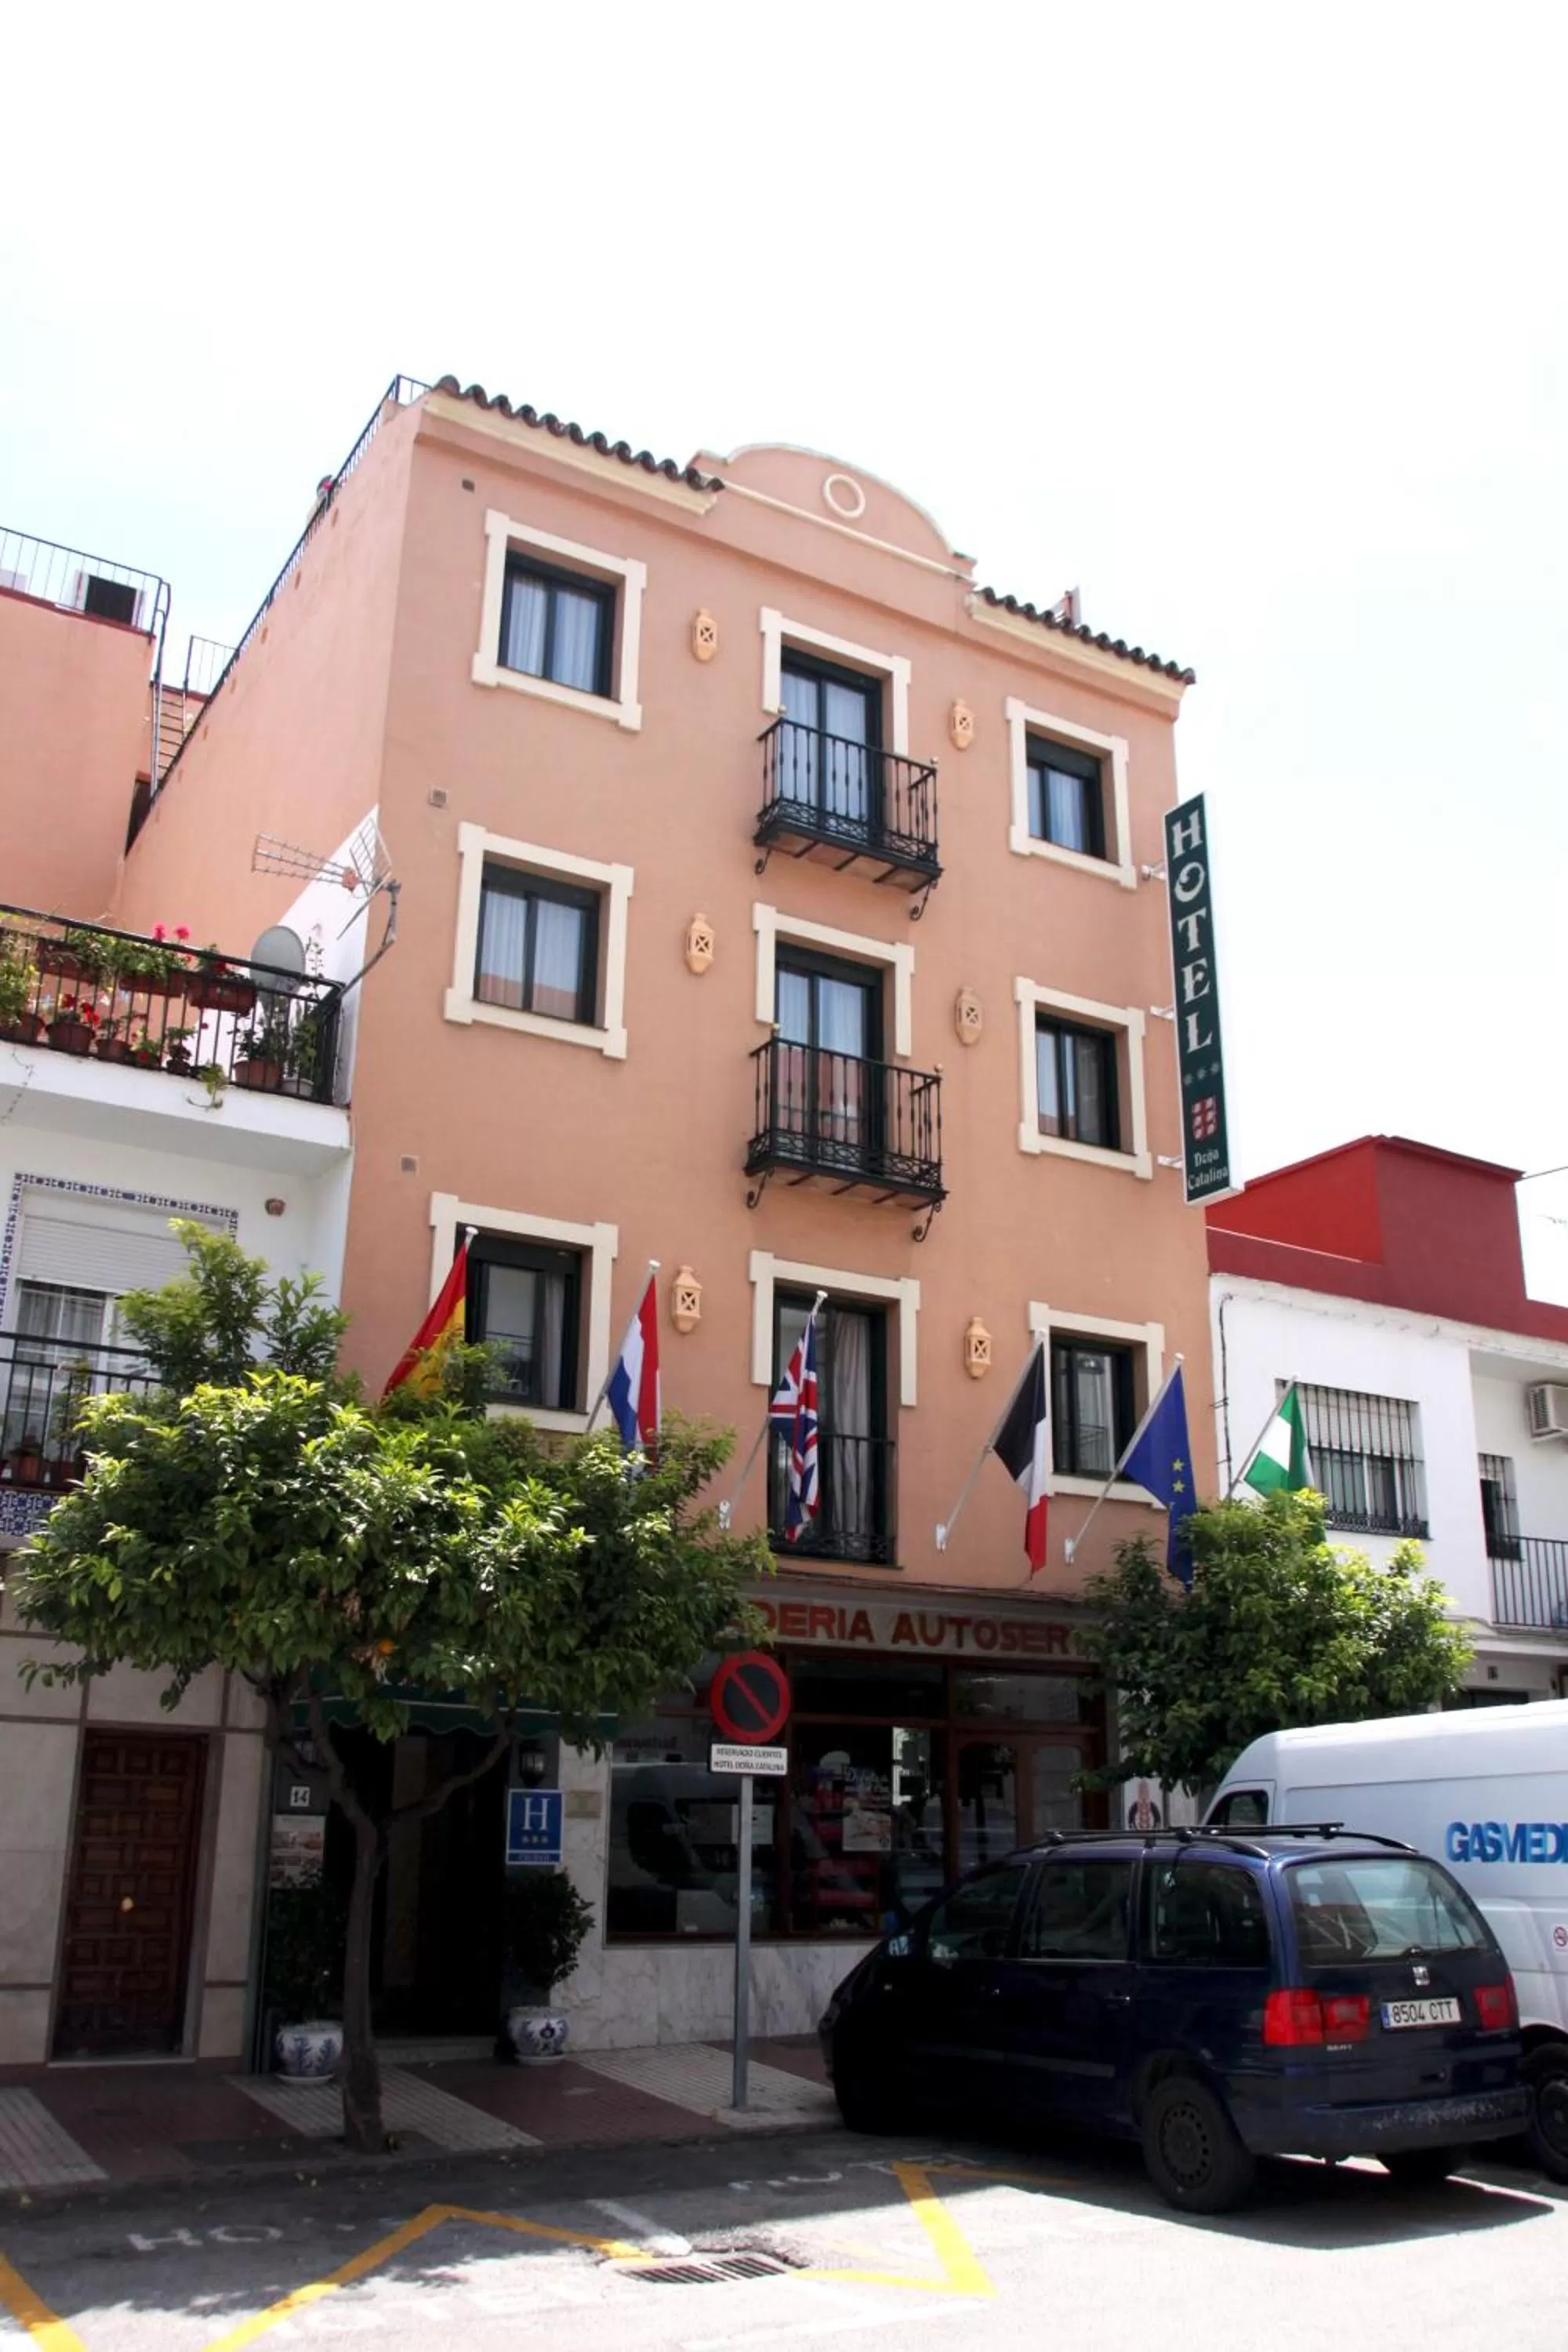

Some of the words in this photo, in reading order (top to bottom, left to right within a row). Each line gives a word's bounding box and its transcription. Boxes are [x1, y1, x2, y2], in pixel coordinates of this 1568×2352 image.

[1171, 810, 1213, 1054] HOTEL
[1188, 1167, 1229, 1190] Catalina
[294, 1791, 308, 1804] 14
[521, 1797, 553, 1831] H
[1391, 2003, 1425, 2024] 8504
[1429, 2001, 1453, 2020] CTT
